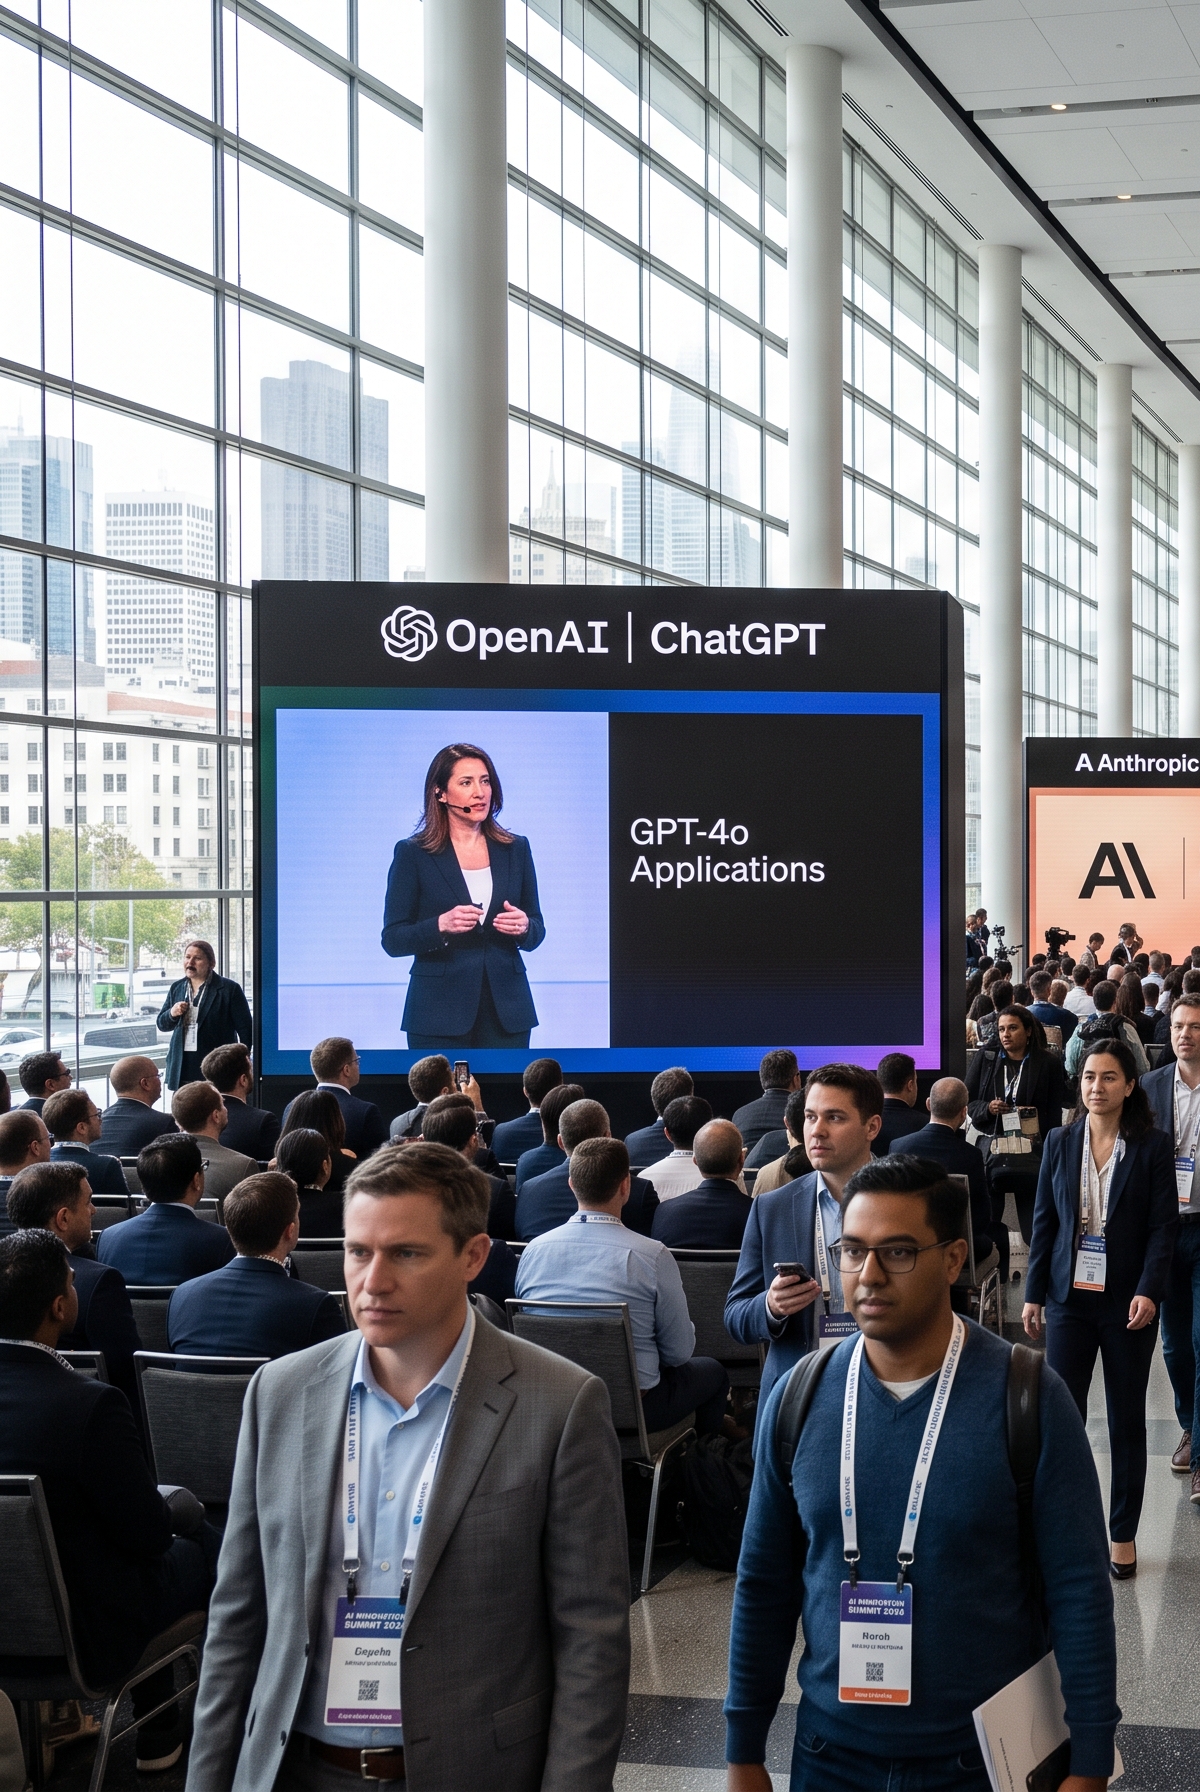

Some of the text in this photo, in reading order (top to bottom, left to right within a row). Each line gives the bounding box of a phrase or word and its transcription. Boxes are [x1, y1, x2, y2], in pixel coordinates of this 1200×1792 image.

[446, 618, 826, 661] OpenAI ChatGPT
[1097, 753, 1200, 777] Anthropic
[630, 817, 750, 846] GPT-4o
[629, 855, 826, 889] Applications
